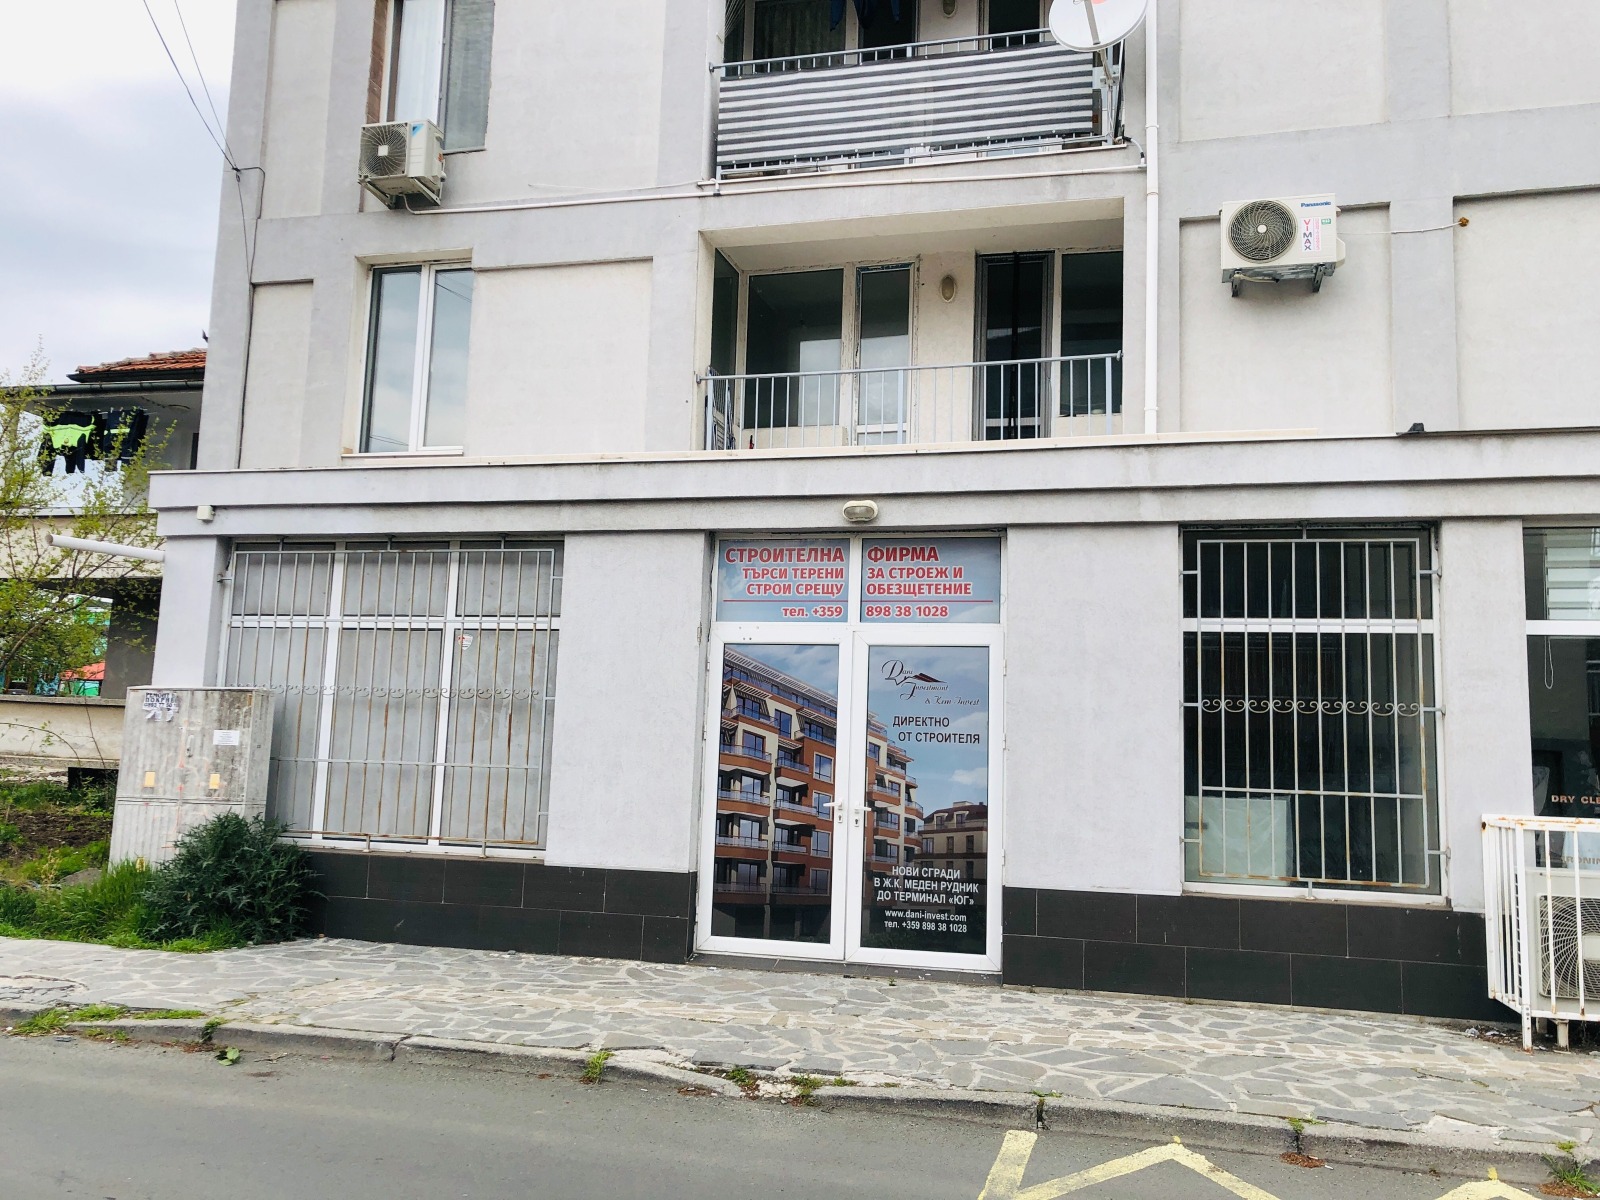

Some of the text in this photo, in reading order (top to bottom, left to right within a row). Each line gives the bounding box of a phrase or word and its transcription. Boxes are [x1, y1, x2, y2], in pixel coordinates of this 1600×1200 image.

[725, 547, 939, 563] СТРОИТЕЛНА ФИРМА
[742, 567, 963, 579] ТЪРСИ ТЕРЕНИ ЗА СТРОЕЖ И
[747, 583, 971, 597] СТРОИ СРЕЩУ ОБЕЗЩЕТЕНИЕ
[783, 606, 948, 617] тел. +359 898 38 1028
[893, 716, 950, 728] ДИРЕКТНО
[898, 732, 980, 744] ОТ СТРОИТЕЛЯ
[1551, 795, 1575, 804] DRY
[892, 866, 960, 880] НОВИ СГРАДИ
[874, 878, 880, 887] В
[904, 880, 938, 891] МЕДЕН
[940, 882, 979, 893] РУДНИК
[877, 891, 891, 901] ДО
[894, 891, 946, 904] ТЕРМИНАЛ
[885, 909, 967, 922] www.dani-invest.com
[884, 920, 967, 933] тел. +359 898 38 1028
